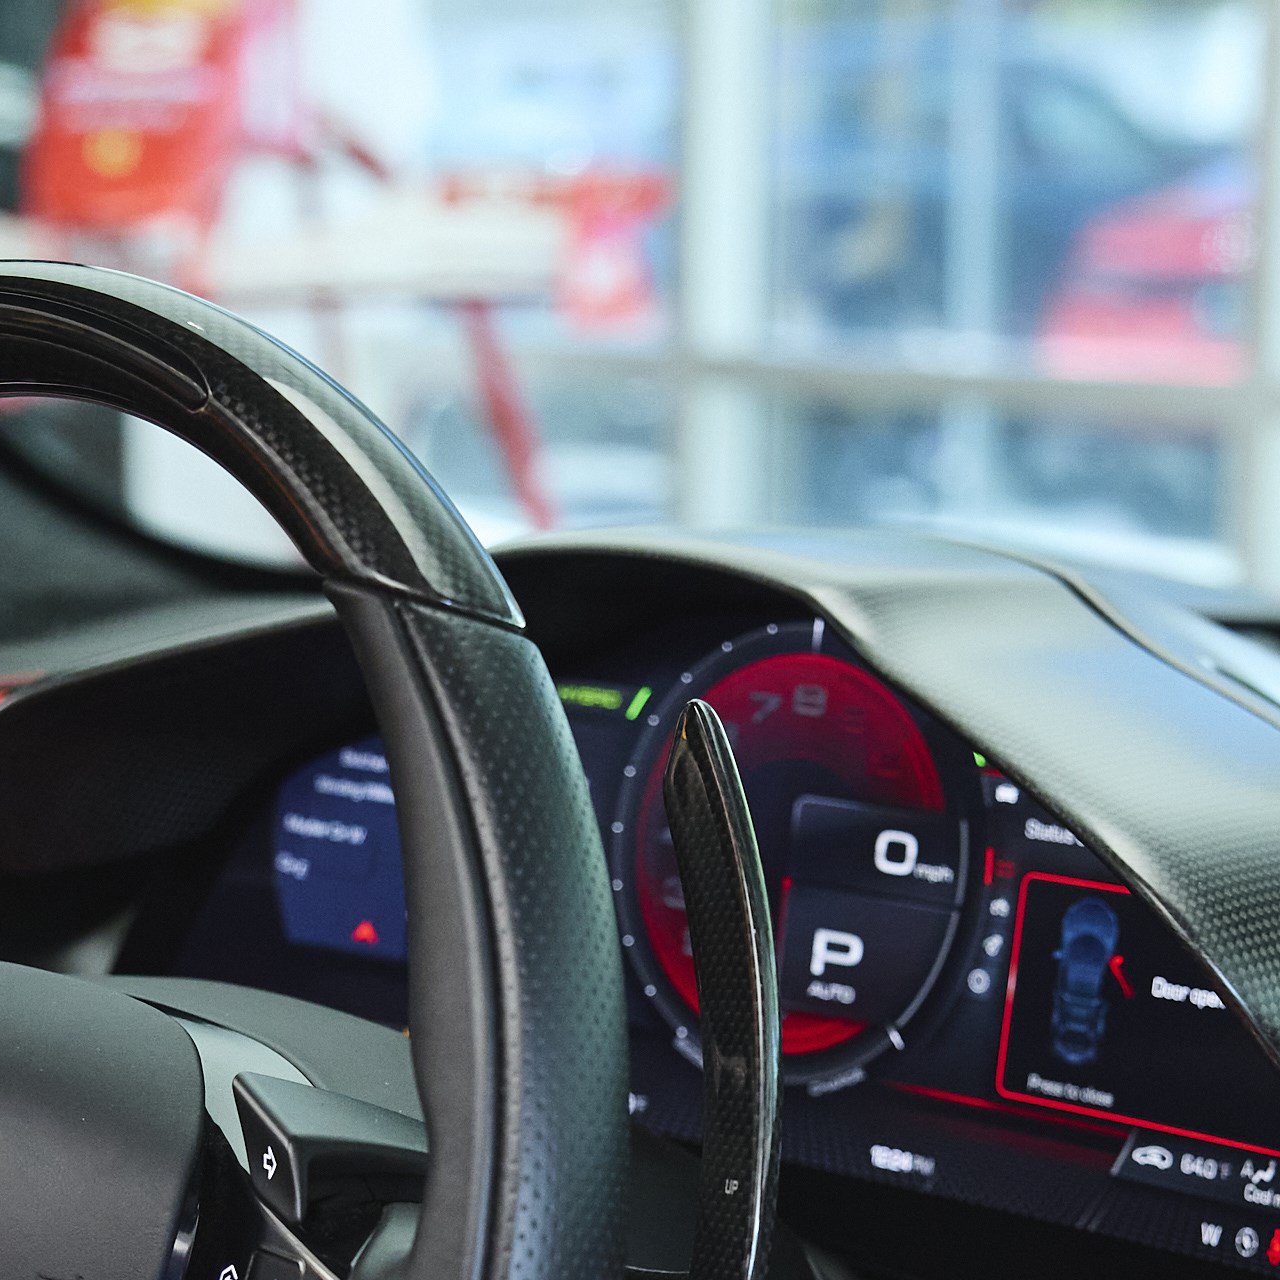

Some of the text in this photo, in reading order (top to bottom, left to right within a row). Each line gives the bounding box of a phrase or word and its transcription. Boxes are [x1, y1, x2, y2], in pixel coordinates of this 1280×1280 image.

[874, 829, 919, 876] 0
[810, 927, 864, 976] P
[807, 980, 856, 1005] AUTO
[1151, 976, 1226, 1010] Door ope
[725, 1179, 739, 1195] UP
